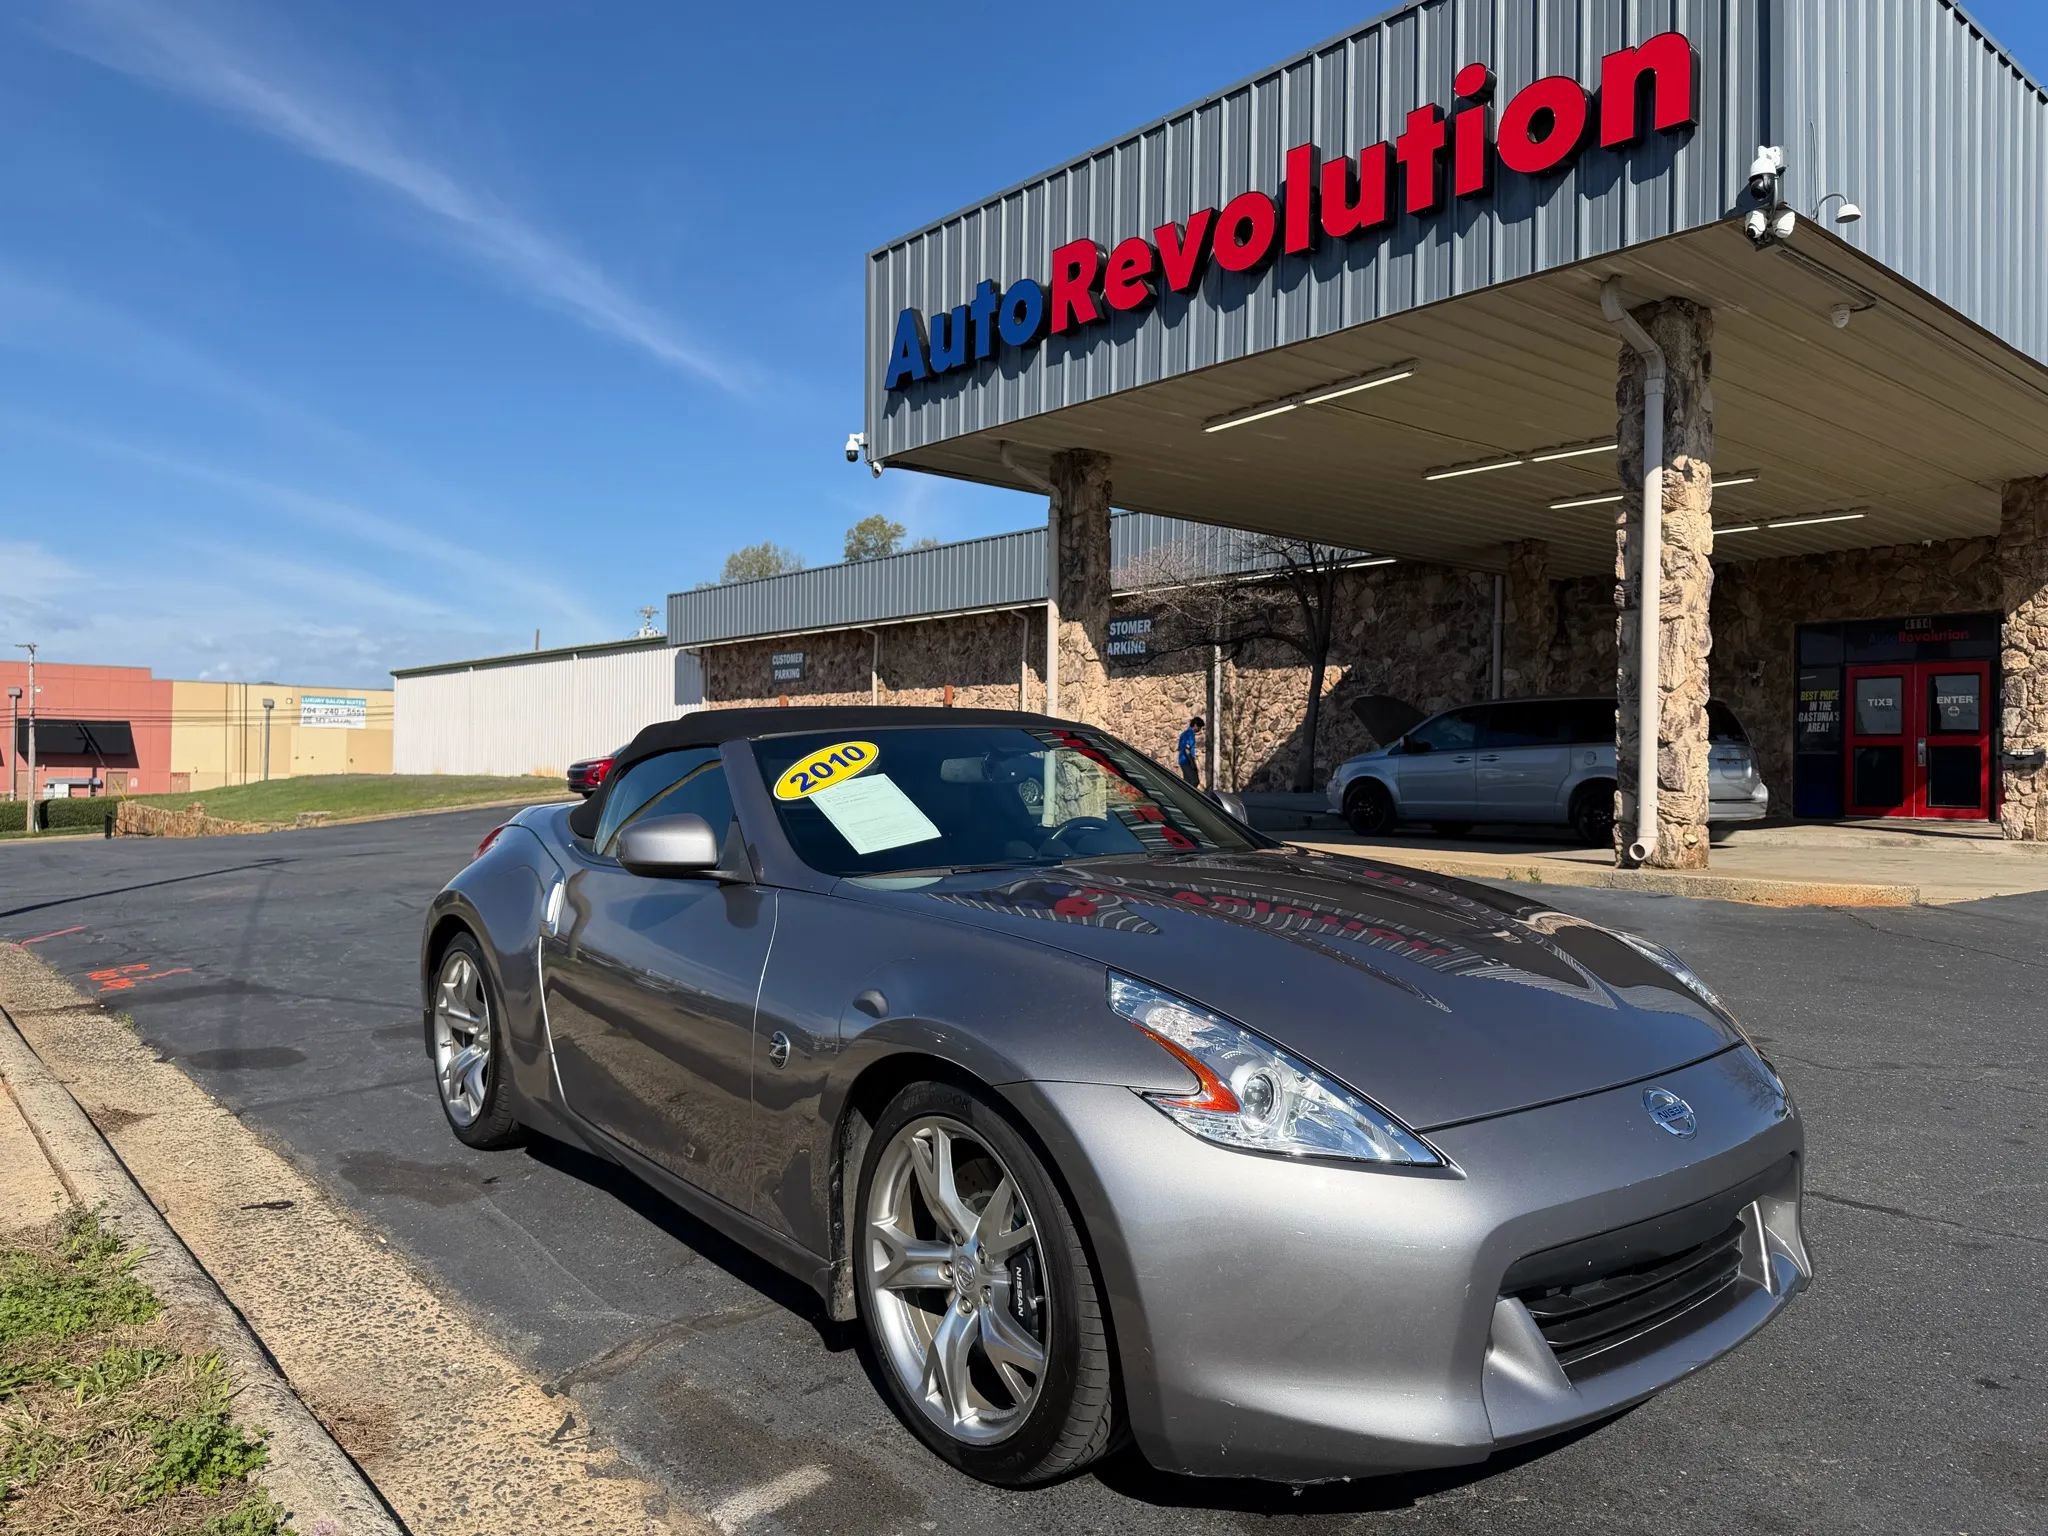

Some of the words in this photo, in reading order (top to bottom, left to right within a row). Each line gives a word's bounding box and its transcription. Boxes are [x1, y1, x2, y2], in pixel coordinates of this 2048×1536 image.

[1109, 620, 1152, 636] STOMER
[1107, 641, 1146, 656] ARKING
[772, 652, 803, 666] CUSTOMER
[774, 668, 800, 680] PARKING
[1800, 690, 1819, 701] BEST
[1819, 690, 1840, 700] PRICE
[1936, 695, 1974, 705] ENTER
[1809, 701, 1818, 711] IN
[1819, 701, 1833, 711] THE
[1798, 711, 1840, 722] GASTONIA'S
[1806, 722, 1830, 733] AREA!
[789, 745, 866, 793] 2010
[1016, 1266, 1024, 1317] NISSAN
